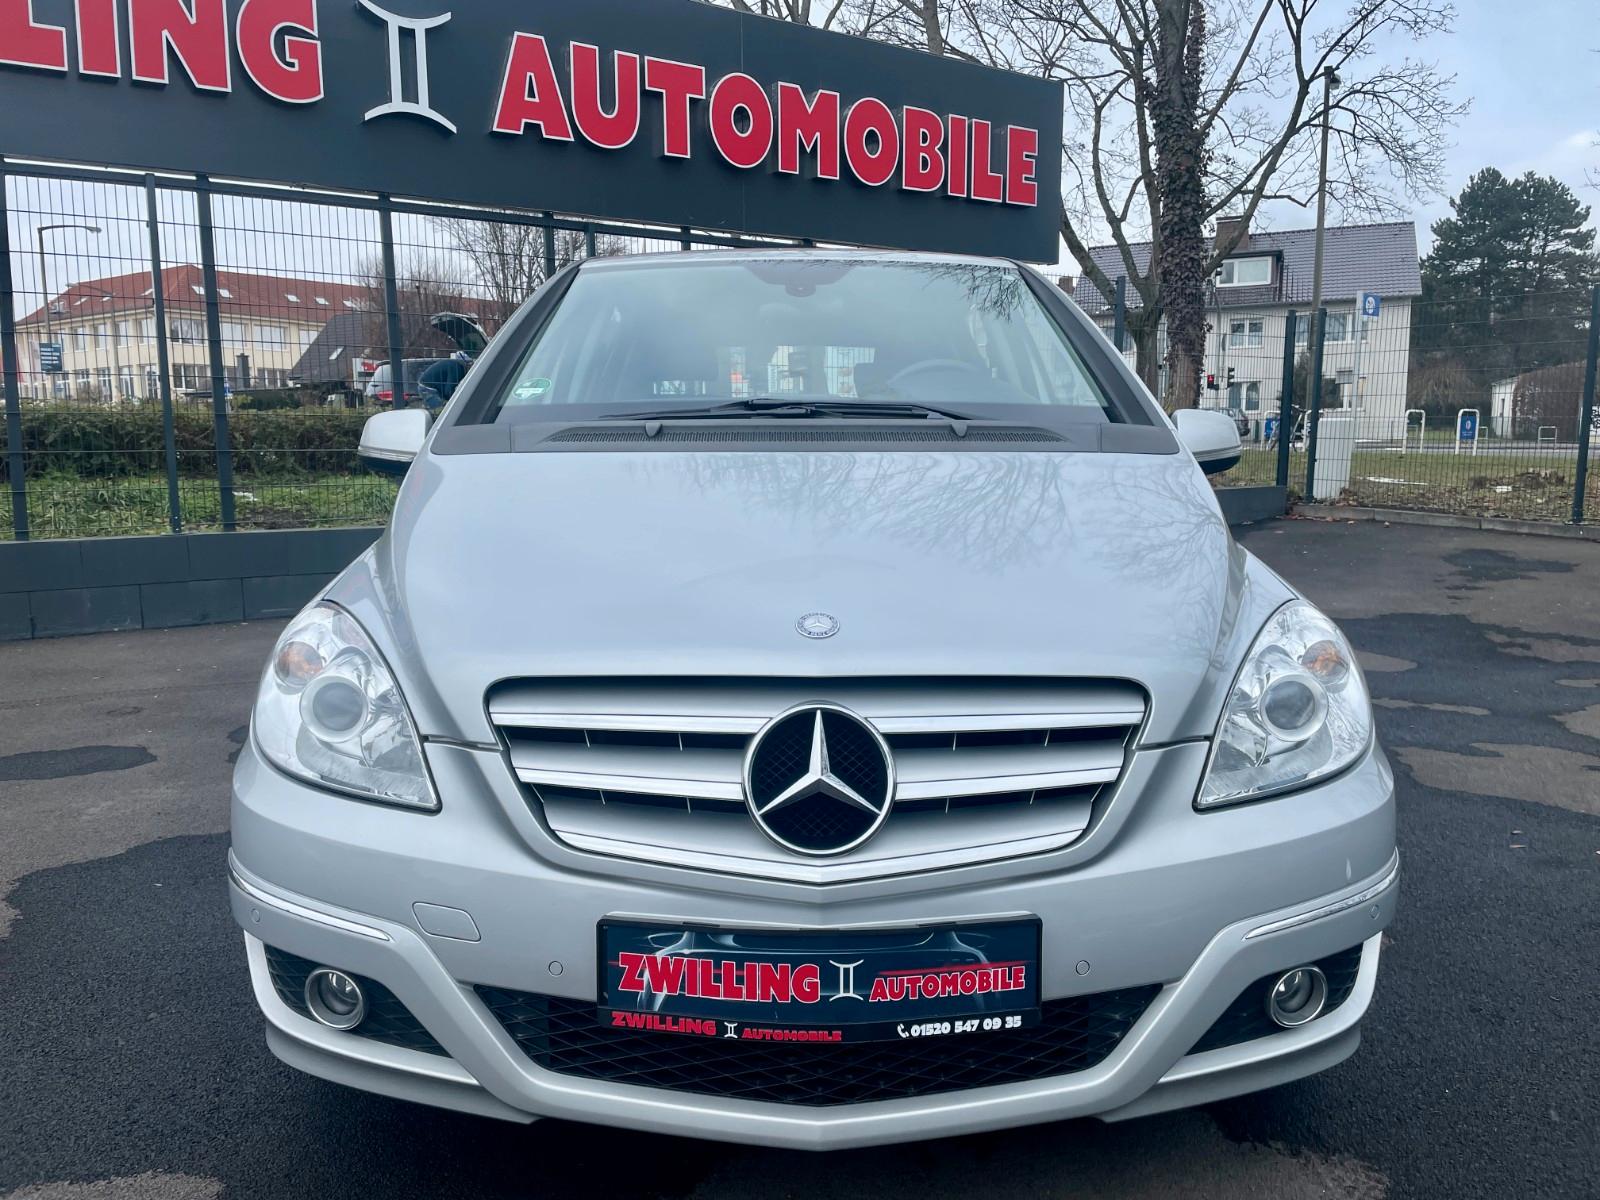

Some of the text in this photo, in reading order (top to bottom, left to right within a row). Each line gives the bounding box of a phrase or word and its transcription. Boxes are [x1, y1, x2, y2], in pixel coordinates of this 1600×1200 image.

[492, 31, 1039, 207] AUTOMOBILE
[618, 952, 1026, 1004] ZWILLING AUTOMOBILE
[611, 1011, 843, 1042] ZWILLING AUTOMOBILE
[910, 1015, 1022, 1037] 01520 547 09 35
